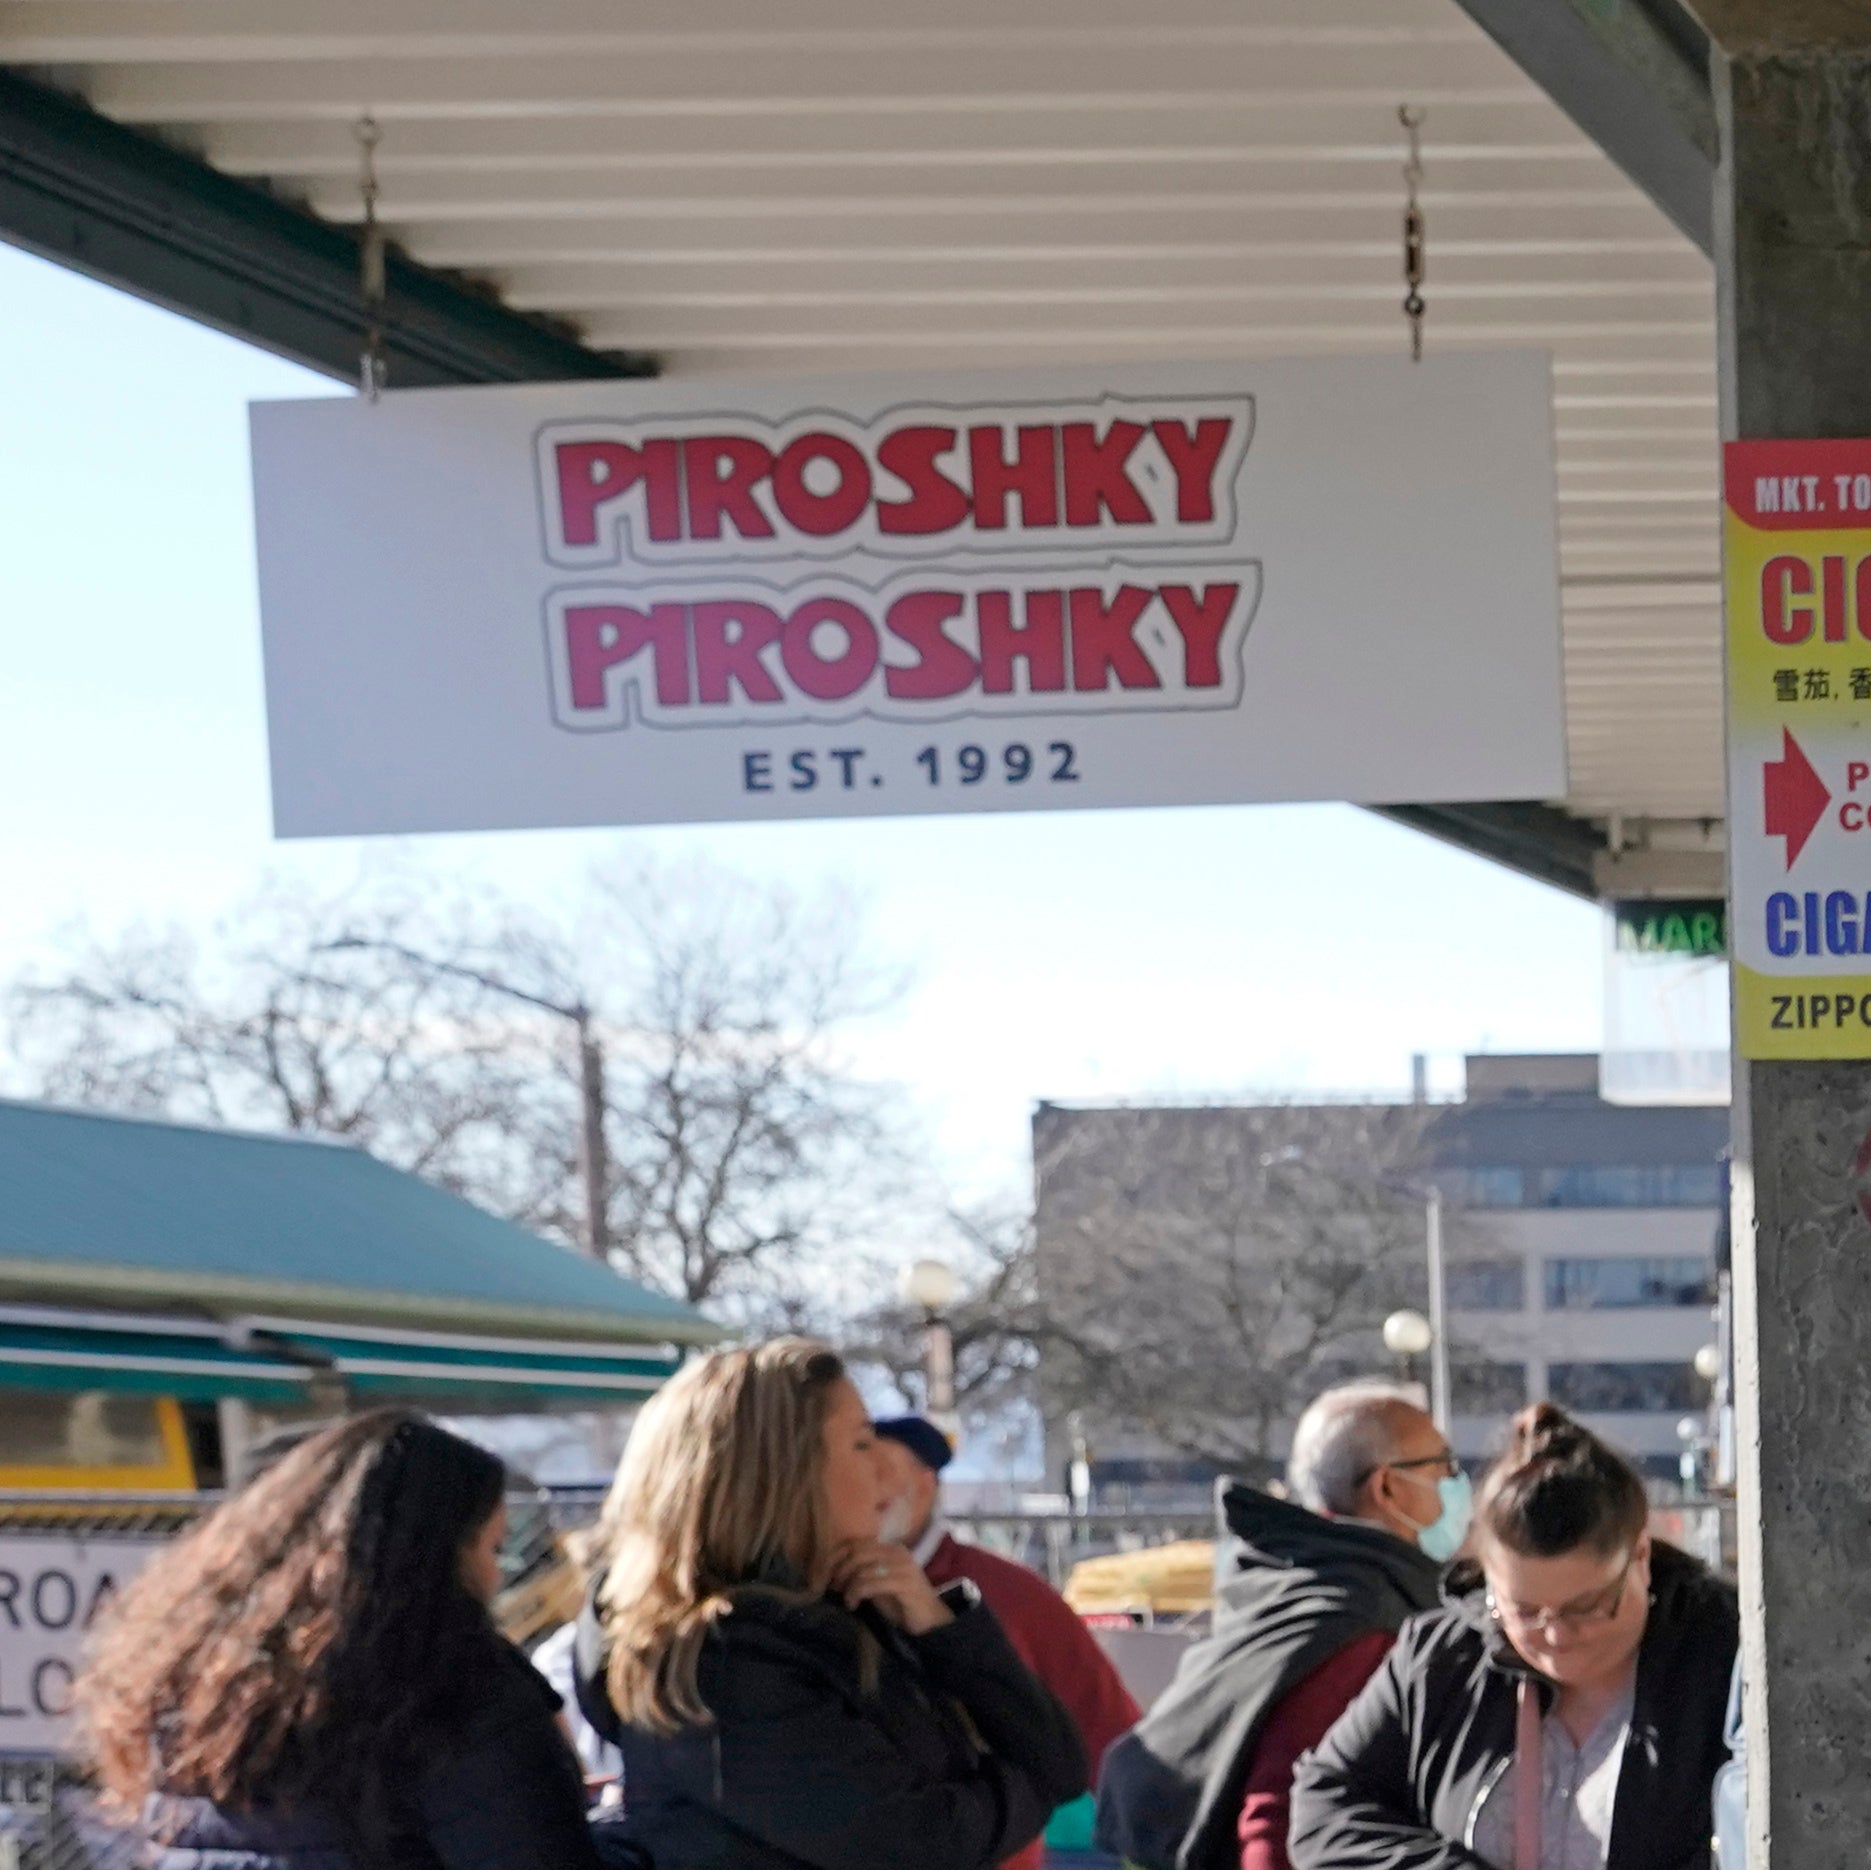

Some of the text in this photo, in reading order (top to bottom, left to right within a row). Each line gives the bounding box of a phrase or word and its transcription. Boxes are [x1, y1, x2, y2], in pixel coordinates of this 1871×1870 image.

[554, 417, 1236, 546] PIROSHKY
[1755, 474, 1826, 513] MKT.
[564, 581, 1241, 710] PIROSHKY
[744, 740, 1082, 793] EST. 1992
